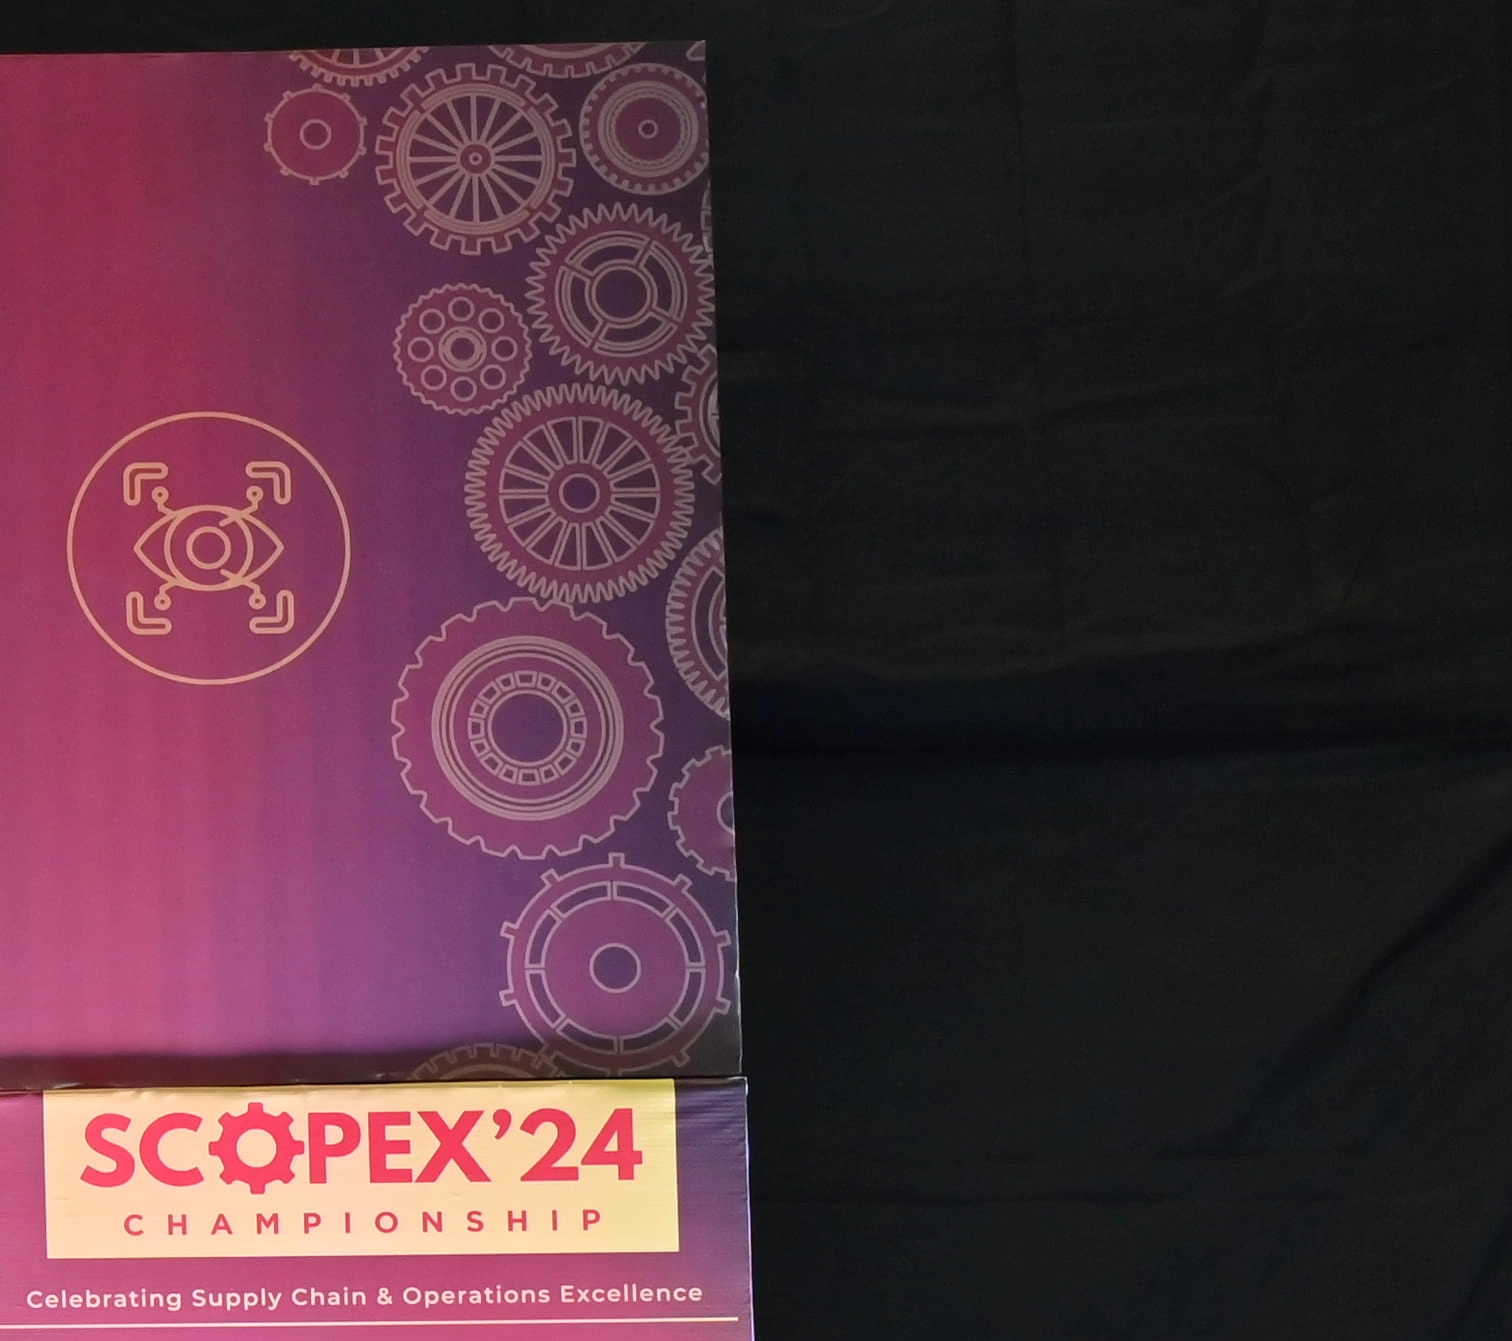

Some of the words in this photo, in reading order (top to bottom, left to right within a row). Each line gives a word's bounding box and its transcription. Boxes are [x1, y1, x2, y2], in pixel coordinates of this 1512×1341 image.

[124, 1209, 600, 1236] CHAMPIONSHIP
[27, 1289, 181, 1311] Celebrating
[192, 1288, 281, 1310] Supply
[292, 1287, 366, 1305] Chain
[377, 1288, 392, 1305] &
[403, 1285, 550, 1308] Operations
[561, 1284, 702, 1302] Excellence
